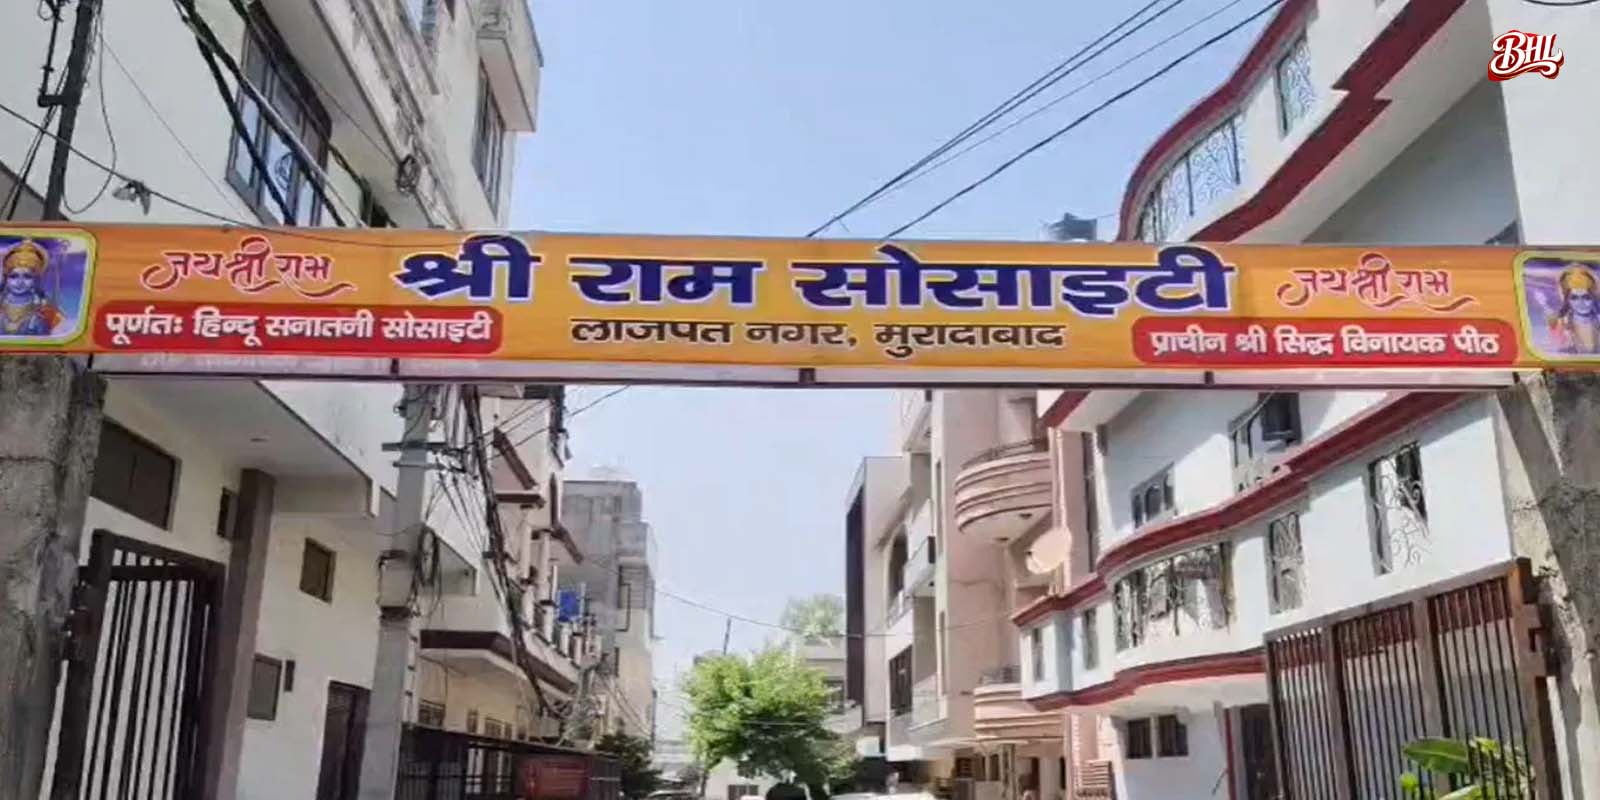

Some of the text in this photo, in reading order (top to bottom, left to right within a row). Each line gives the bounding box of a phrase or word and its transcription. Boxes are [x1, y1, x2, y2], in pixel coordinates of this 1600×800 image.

[142, 236, 354, 297] जय श्री राम
[394, 234, 1235, 315] श्री राम सोसाइटी
[1277, 253, 1475, 312] जय श्री राम
[106, 305, 493, 347] पूर्णतः हिन्दू सनातनी सोसाइटी
[571, 319, 1066, 358] लाजपत नगर, मुरादाबाद
[1150, 324, 1500, 356] प्राचीन श्री सिद्ध विनायक पीठ
